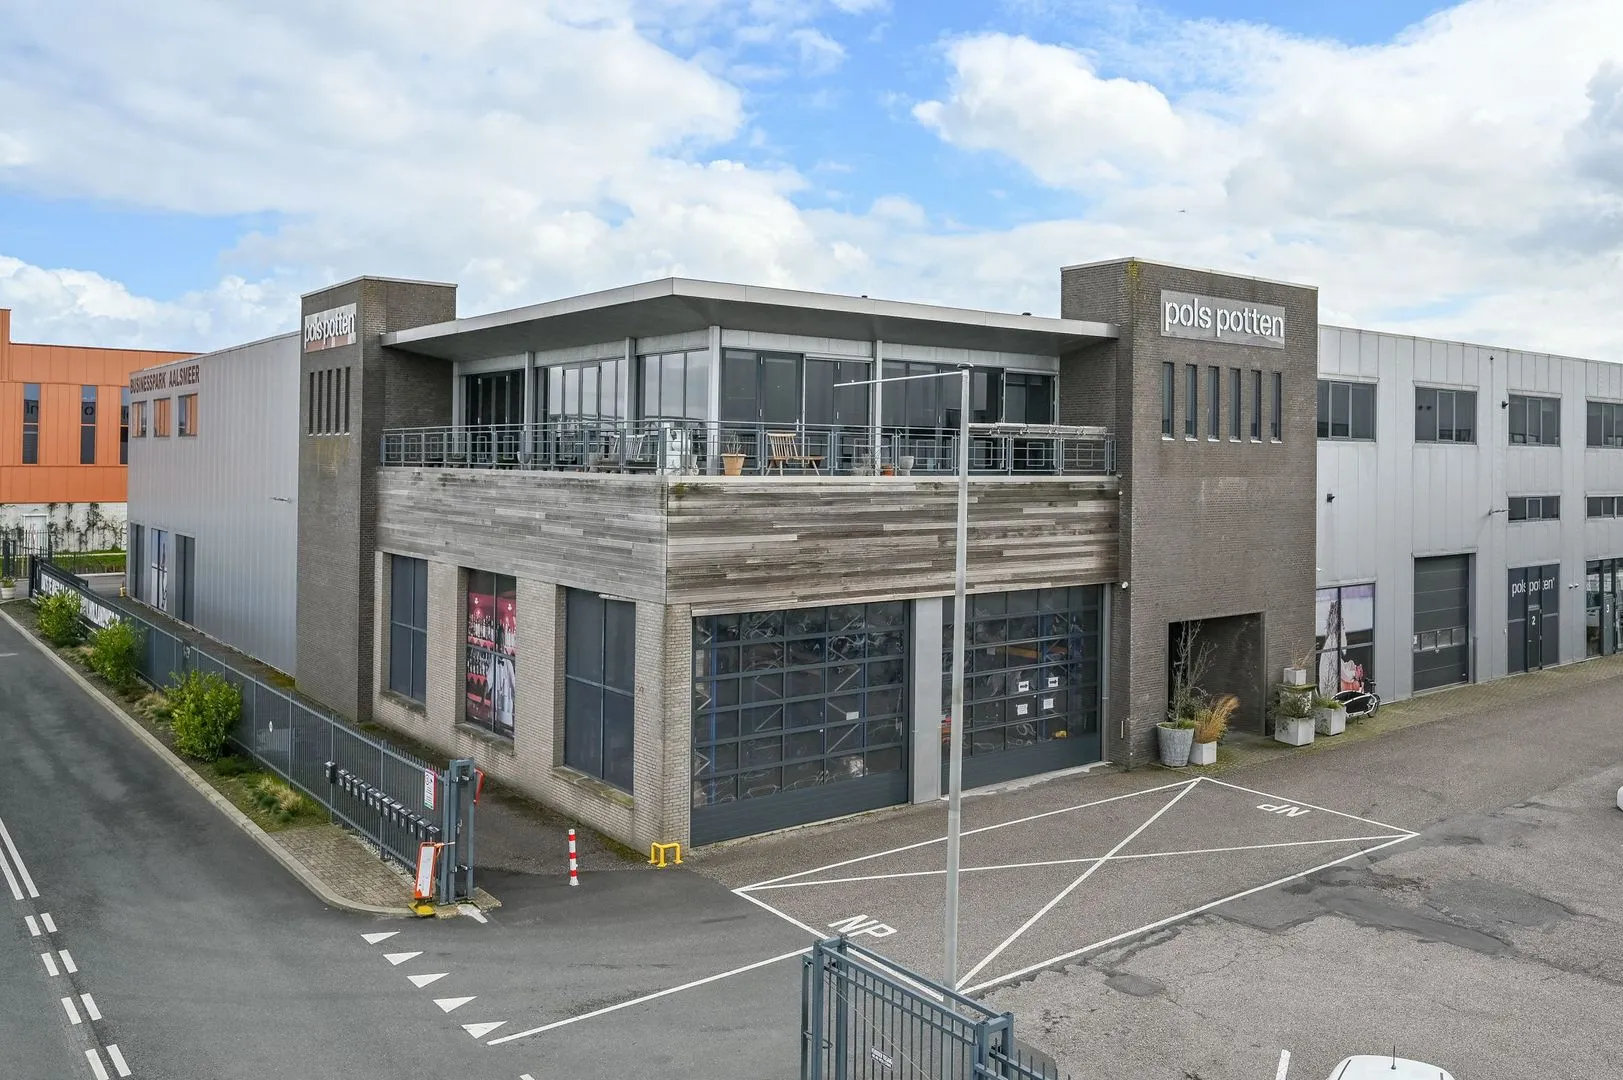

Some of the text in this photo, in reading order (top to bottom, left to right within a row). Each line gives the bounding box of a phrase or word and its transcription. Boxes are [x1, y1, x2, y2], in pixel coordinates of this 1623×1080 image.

[1165, 297, 1284, 338] pols potten
[304, 312, 355, 349] pols potten
[130, 364, 200, 394] BUSINESSPARK AALSMEER
[1528, 577, 1554, 596] poten
[1531, 616, 1536, 625] 2
[1256, 803, 1311, 818] NP
[827, 914, 898, 938] NP
